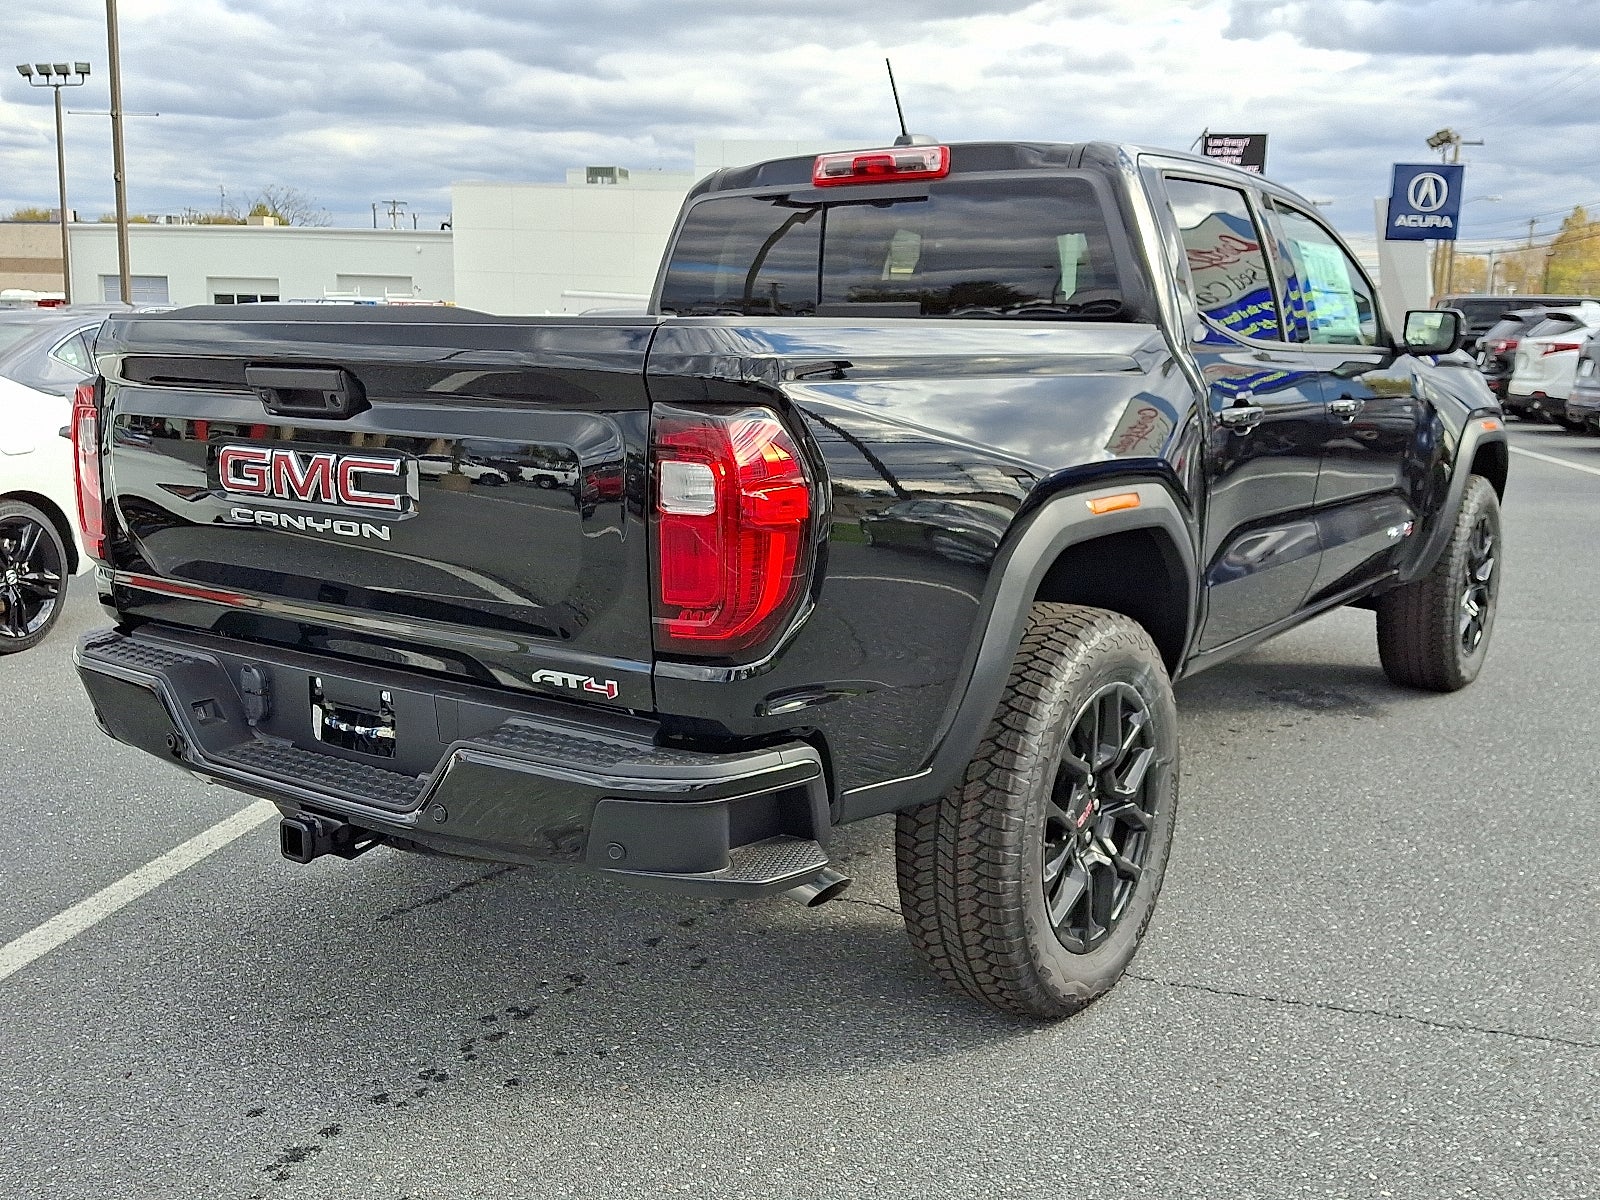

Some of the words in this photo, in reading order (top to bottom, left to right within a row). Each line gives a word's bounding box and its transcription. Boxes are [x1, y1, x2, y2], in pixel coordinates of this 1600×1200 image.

[1394, 213, 1454, 229] ACURA
[219, 442, 403, 511] GMC
[230, 507, 391, 541] CANYON
[531, 668, 619, 700] AT4
